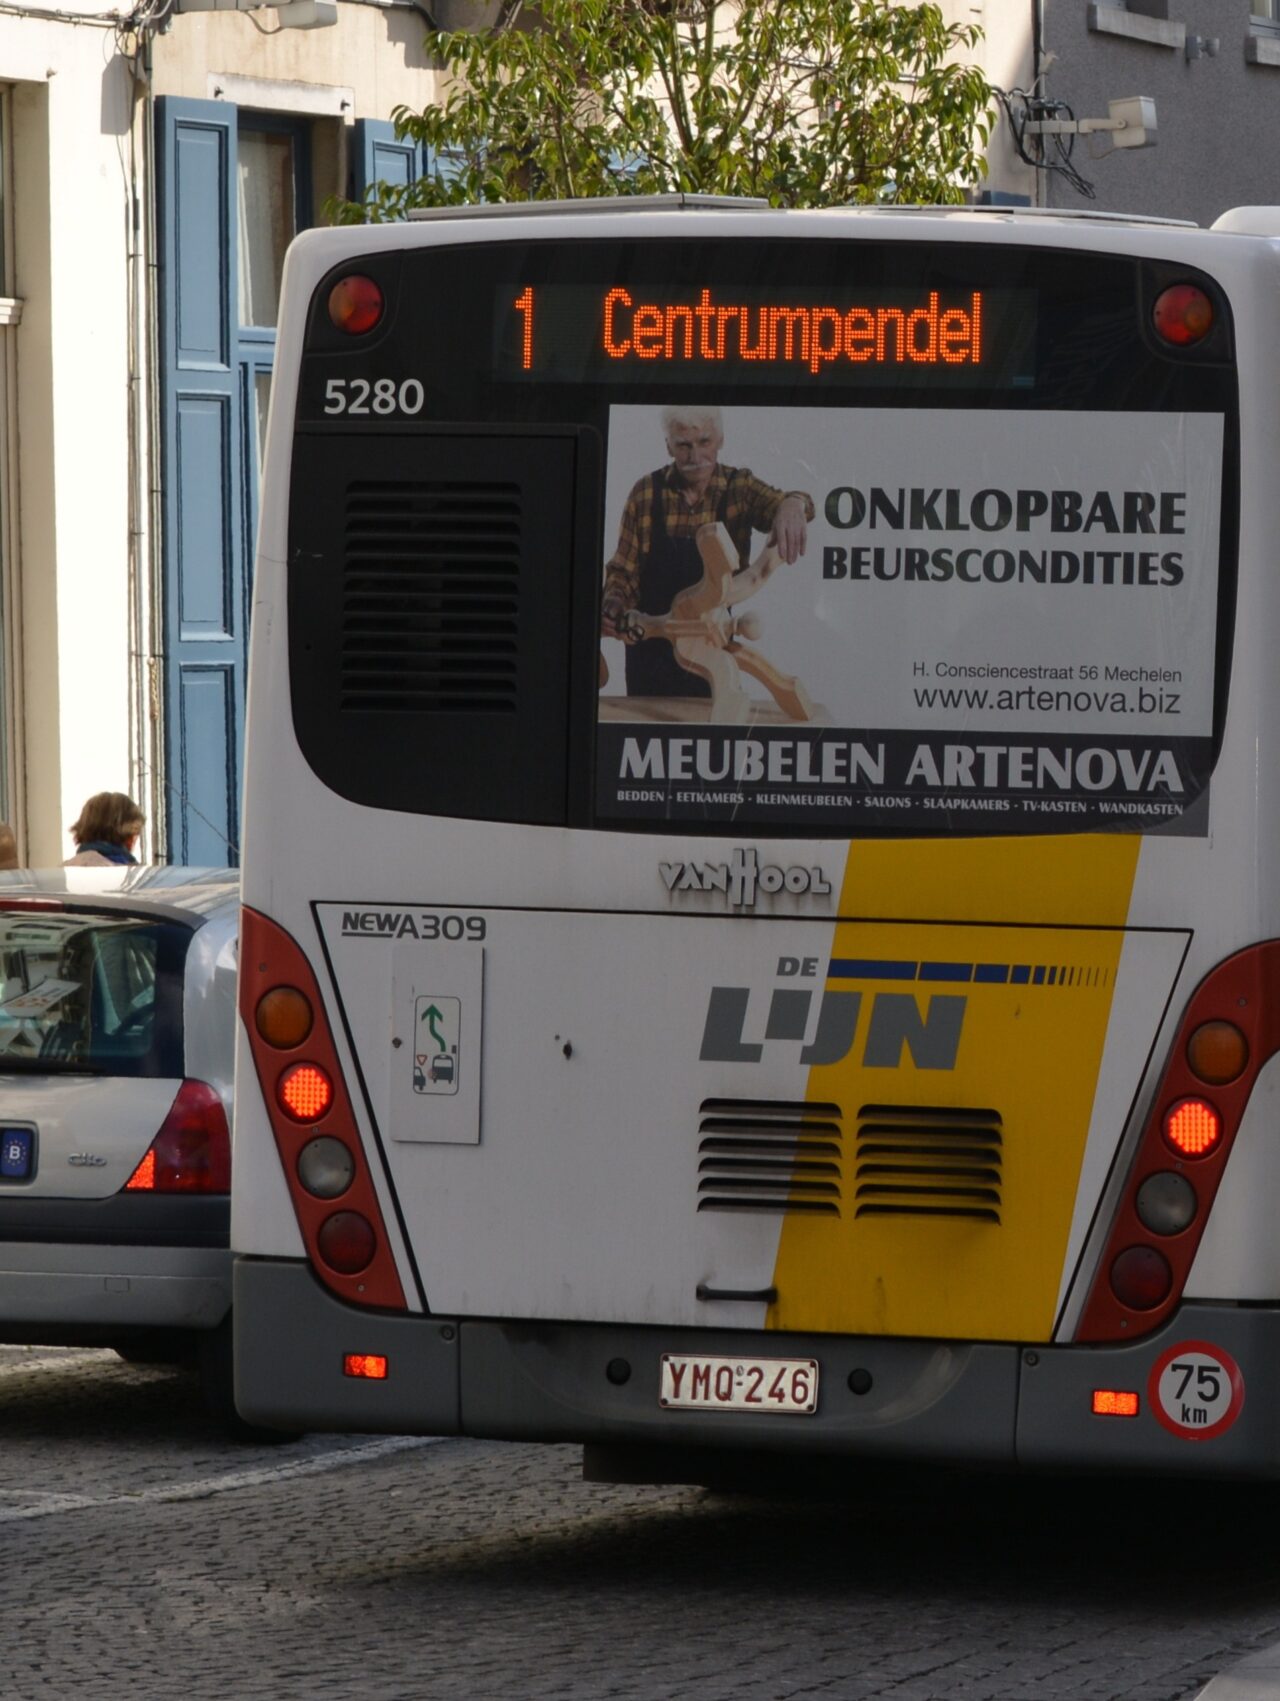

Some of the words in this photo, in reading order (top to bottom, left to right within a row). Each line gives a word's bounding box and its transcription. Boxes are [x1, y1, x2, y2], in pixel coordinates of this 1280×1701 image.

[514, 286, 533, 369] 1
[603, 287, 982, 374] Centrumpendel
[323, 378, 425, 415] 5280
[824, 486, 1186, 535] ONKLOPBARE
[822, 546, 1184, 586] BEURSCONDITIES
[912, 661, 930, 677] H.
[935, 661, 1074, 681] Consciencestraat
[1078, 665, 1099, 681] 56
[1104, 666, 1183, 683] Mechelen
[913, 685, 1181, 715] www.artenova.biz
[619, 737, 885, 785] MEUBELEN
[904, 744, 1184, 792] ARTENOVA
[617, 790, 665, 802] BEDDEN
[676, 791, 744, 804] EETKAMERS
[756, 794, 852, 807] KLEINMEUBELEN
[864, 796, 911, 808] SALONS
[923, 797, 1010, 811] SLAAPKAMERS
[1098, 802, 1183, 815] WANDKASTEN
[776, 957, 819, 977] DE
[698, 986, 968, 1071] LIJN
[9, 1145, 21, 1160] B
[1171, 1363, 1221, 1403] 75
[1181, 1403, 1207, 1424] km
